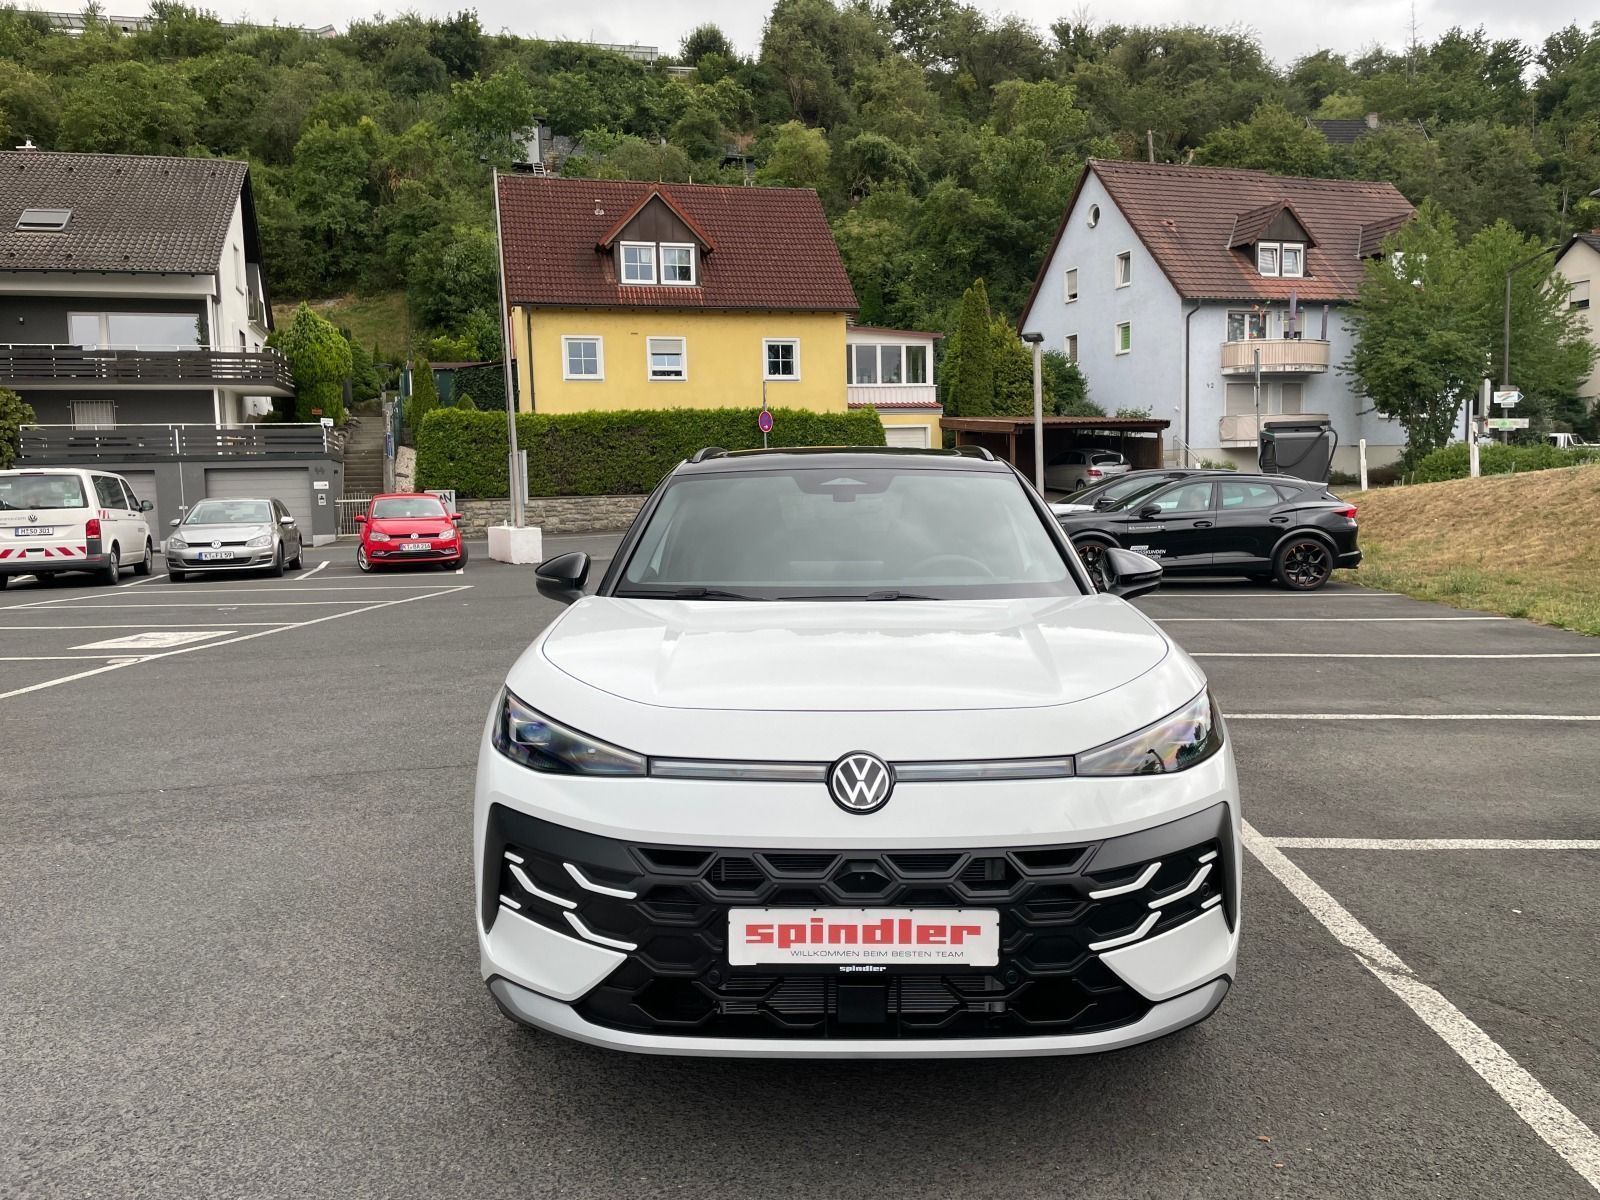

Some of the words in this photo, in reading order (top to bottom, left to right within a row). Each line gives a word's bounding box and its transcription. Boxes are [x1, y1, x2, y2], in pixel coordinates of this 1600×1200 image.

[833, 755, 889, 808] VW
[745, 917, 981, 949] spindler
[839, 965, 887, 973] spindler
